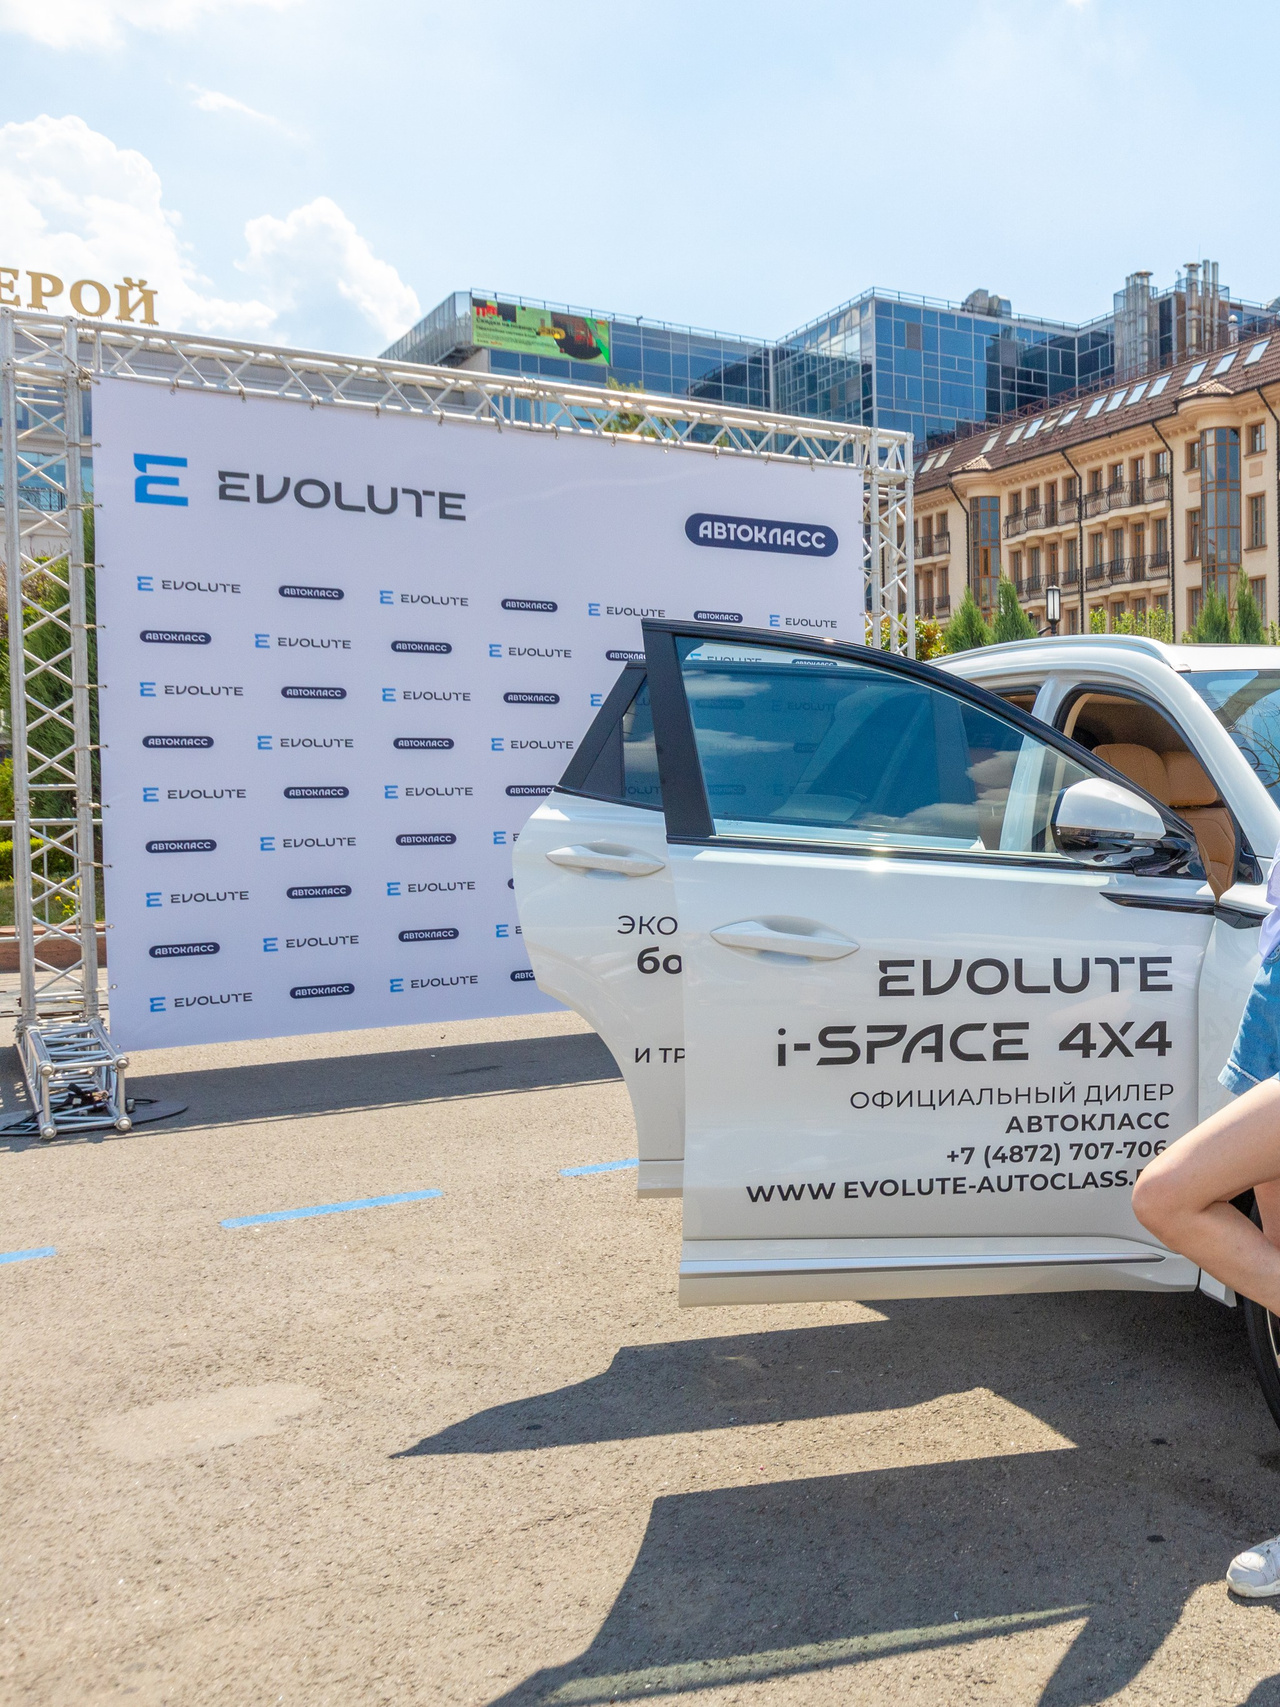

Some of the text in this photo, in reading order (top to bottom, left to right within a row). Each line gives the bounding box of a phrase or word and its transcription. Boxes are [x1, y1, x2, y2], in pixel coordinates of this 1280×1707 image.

[217, 470, 467, 521] EVOLUTE
[698, 521, 826, 549] АВТОКЛАСС
[161, 579, 241, 594] EVOLUTE
[283, 587, 339, 598] АВТОКЛАСС
[400, 593, 469, 607] EVOLUTE
[505, 600, 553, 611] АВТОКЛАСС
[606, 606, 666, 618] EVOLUTE
[697, 612, 739, 622] АВТОКЛАСС
[785, 617, 838, 629] EVOLUTE
[145, 632, 206, 643] АВТОКЛАСС
[277, 637, 352, 650] EVOLUTE
[395, 642, 447, 652] АВТОКЛАСС
[508, 647, 572, 659] EVOLUTE
[164, 685, 244, 697] EVOLUTE
[285, 688, 343, 697] АВТОКЛАСС
[403, 690, 471, 702] EVOLUTE
[507, 694, 556, 703] АВТОКЛАСС
[147, 738, 209, 747] АВТОКЛАСС
[280, 738, 354, 748] EVOLUTE
[397, 739, 450, 748] АВТОКЛАСС
[510, 740, 574, 750] EVOLUTE
[167, 788, 247, 800] EVOLUTE
[288, 788, 344, 797] АВТОКЛАСС
[405, 787, 474, 797] EVOLUTE
[509, 787, 555, 795] АВТОКЛАС
[282, 837, 357, 848] EVOLUTE
[400, 835, 452, 844] АВТОКЛАСС
[151, 841, 211, 851] АВТОКЛАСС
[291, 887, 347, 897] АВТОКЛАСС
[407, 881, 476, 893] EVOLUTE
[170, 890, 250, 904] EVOLUTE
[403, 930, 454, 940] АВТОКЛАСС
[285, 934, 360, 949] EVOLUTE
[154, 944, 215, 956] АВТОКЛАСС
[410, 975, 479, 989] EVOLUTE
[879, 956, 1174, 997] EVOLUTE
[295, 985, 351, 996] АВТОКЛАСС
[174, 992, 253, 1008] EVOLUTE
[777, 1020, 1173, 1067] i-SPACE 4X4
[634, 1047, 651, 1064] И
[849, 1081, 1175, 1111] ОФИЦИАЛЬНЫЙ ДИЛЕР
[1005, 1111, 1171, 1134] АВТОКЛАСС
[946, 1140, 1167, 1169] +7 (4872) 707-706
[746, 1182, 836, 1203] WWW
